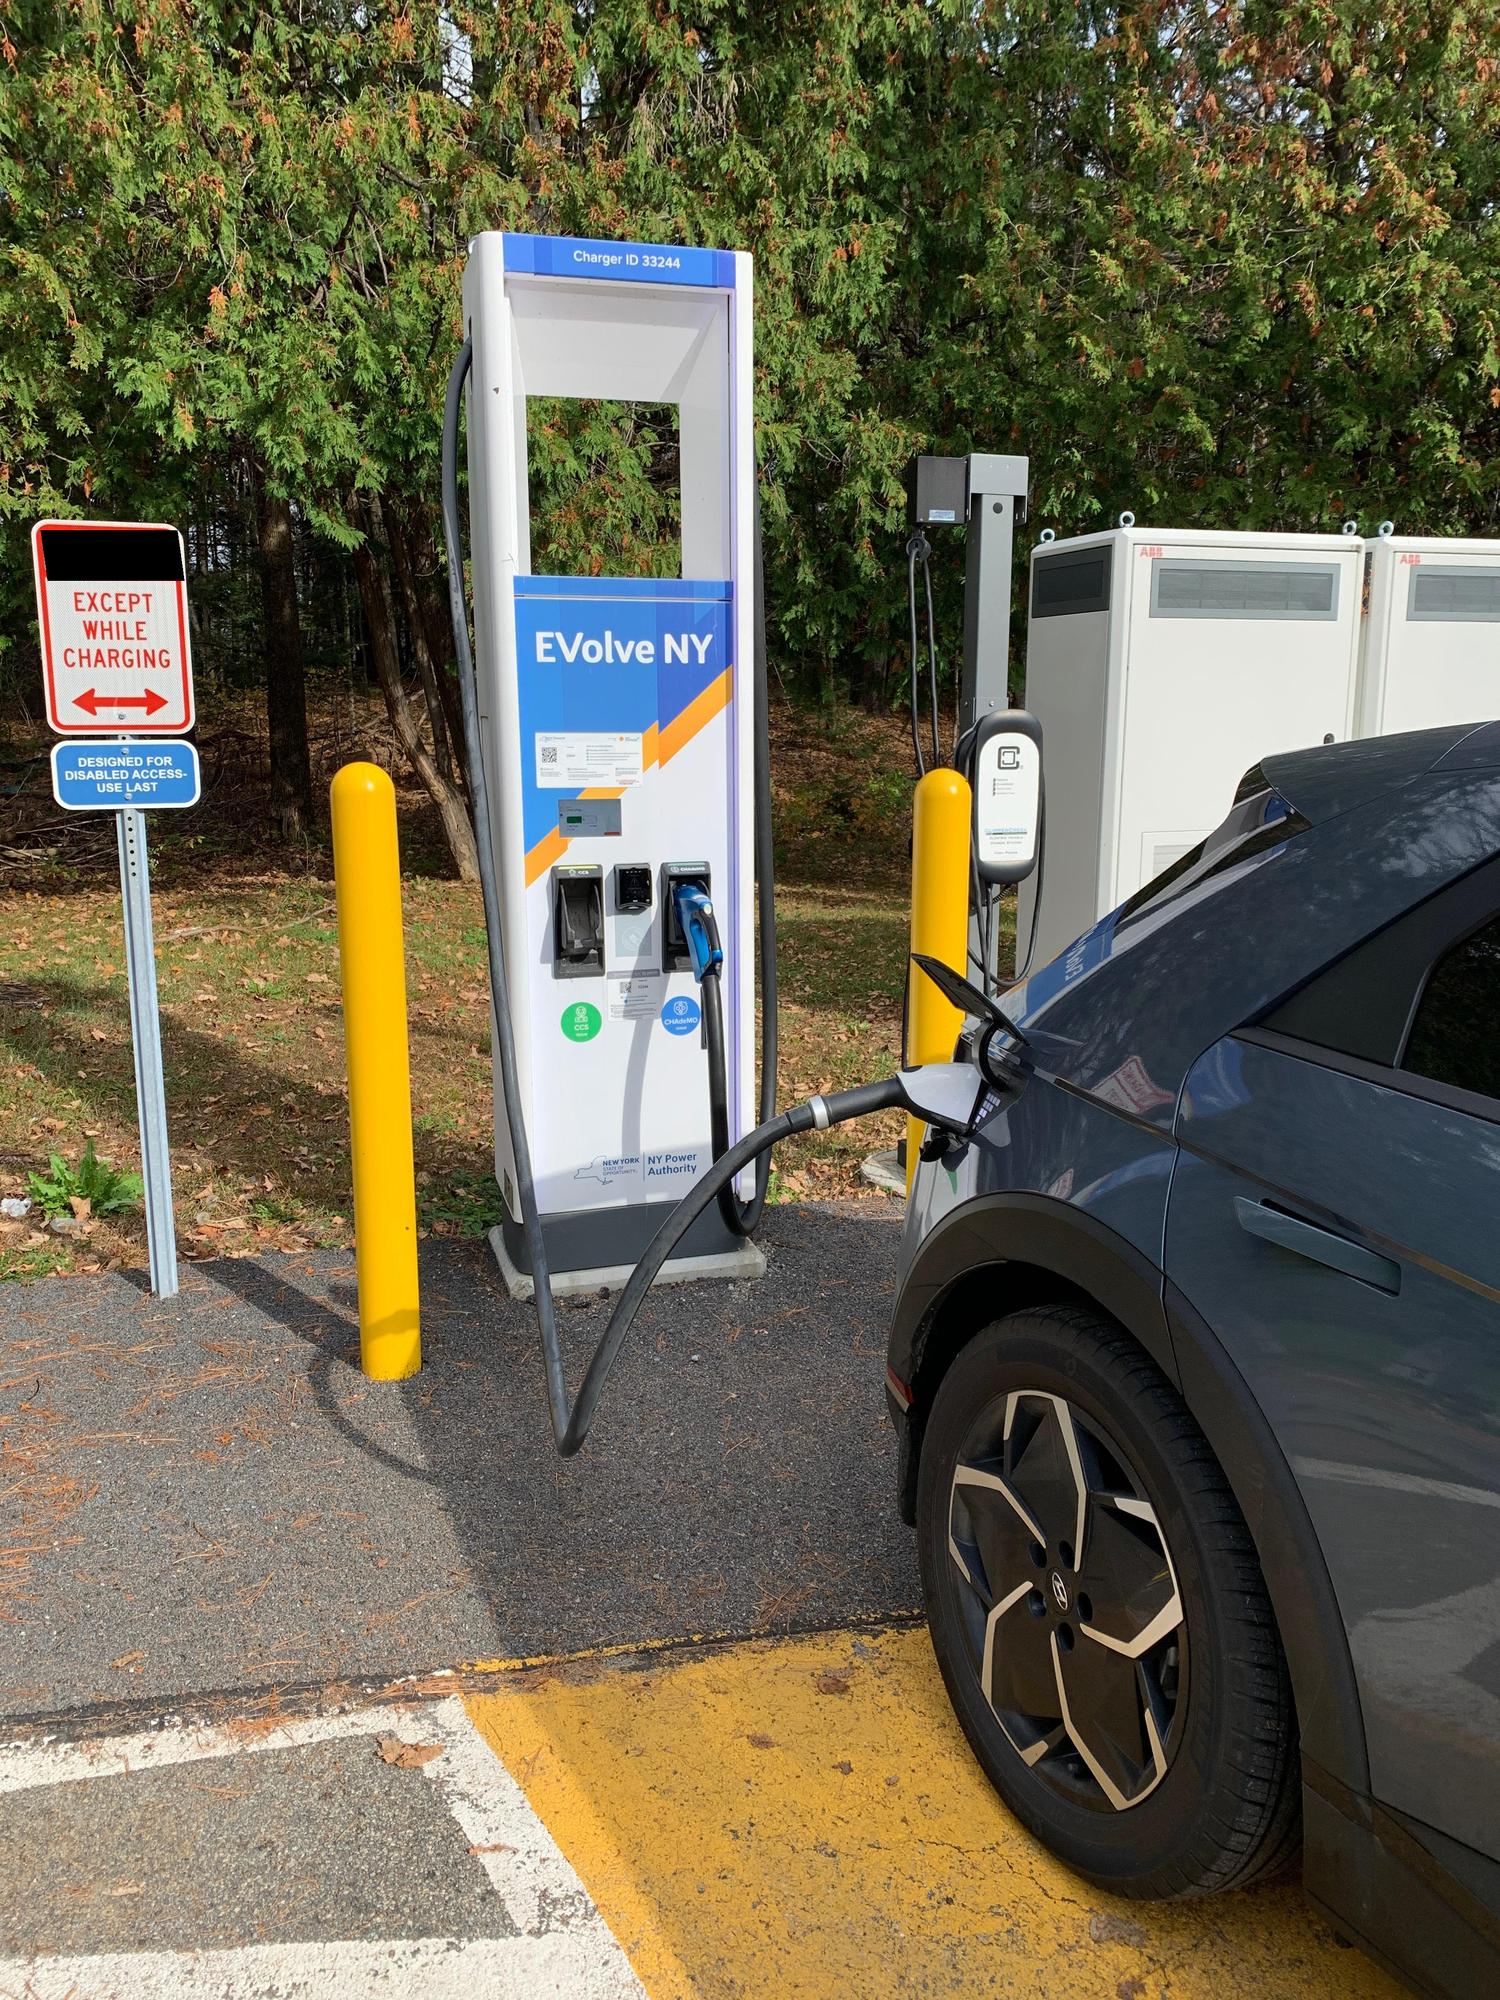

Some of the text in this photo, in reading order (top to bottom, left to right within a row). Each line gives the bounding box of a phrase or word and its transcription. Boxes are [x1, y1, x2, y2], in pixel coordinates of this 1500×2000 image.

[573, 250, 681, 269] Charger ID 33244
[1140, 546, 1163, 557] ABB
[73, 591, 153, 613] EXCEPT
[82, 620, 148, 641] WHILE
[535, 630, 713, 665] EVolve NY
[63, 647, 171, 669] CHARGING
[78, 756, 173, 767] DESIGNED FOR
[65, 769, 188, 781] DISABLED ACCESS-
[96, 782, 158, 793] USE LAST
[664, 1017, 698, 1026] CHAdeMO
[647, 1153, 697, 1165] NY Power
[647, 1164, 697, 1176] Authority
